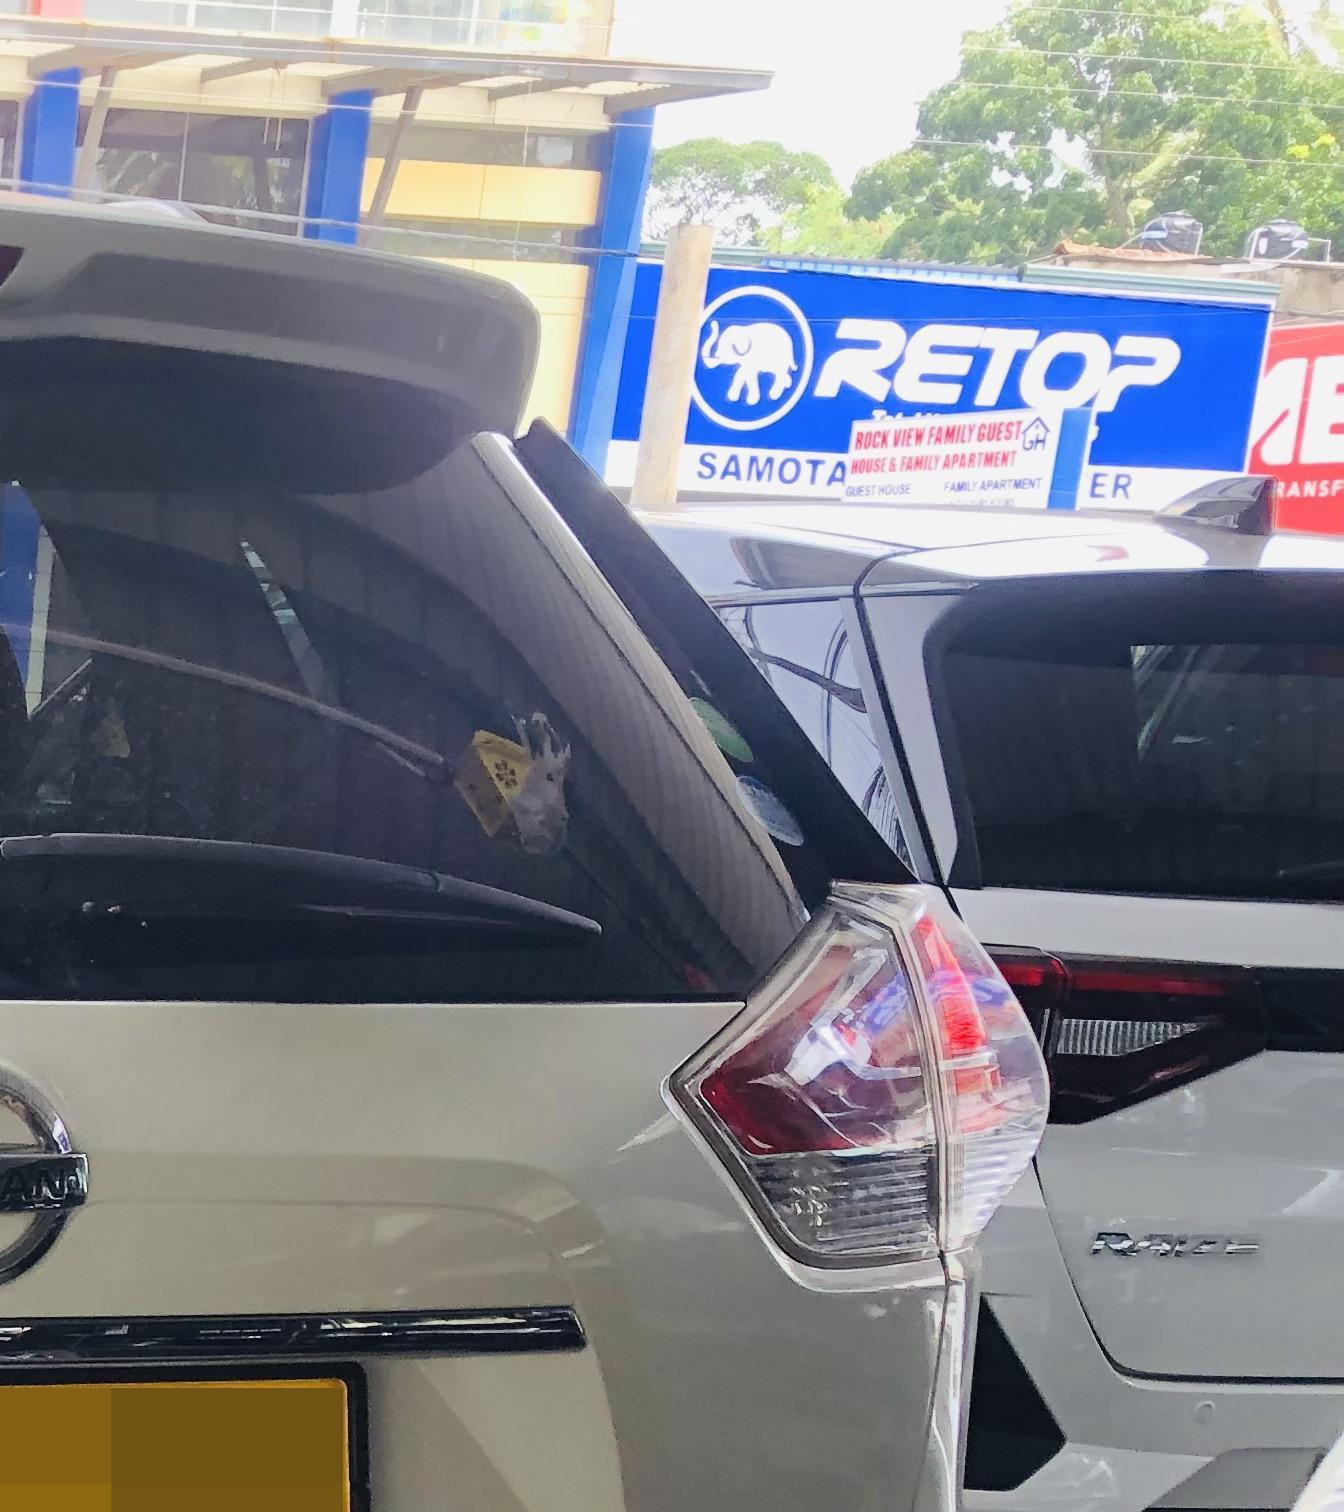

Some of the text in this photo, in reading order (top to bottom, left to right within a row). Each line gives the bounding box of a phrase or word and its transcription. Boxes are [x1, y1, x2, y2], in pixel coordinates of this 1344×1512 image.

[814, 318, 1182, 413] RETOP
[855, 420, 1024, 450] ROCK VIEW FAMILY GUEST
[850, 451, 1018, 475] HOUSE & FAMILY APARTMENT
[845, 483, 912, 497] GUEST HOUSE
[944, 477, 1043, 492] FAMILY APARTMENT
